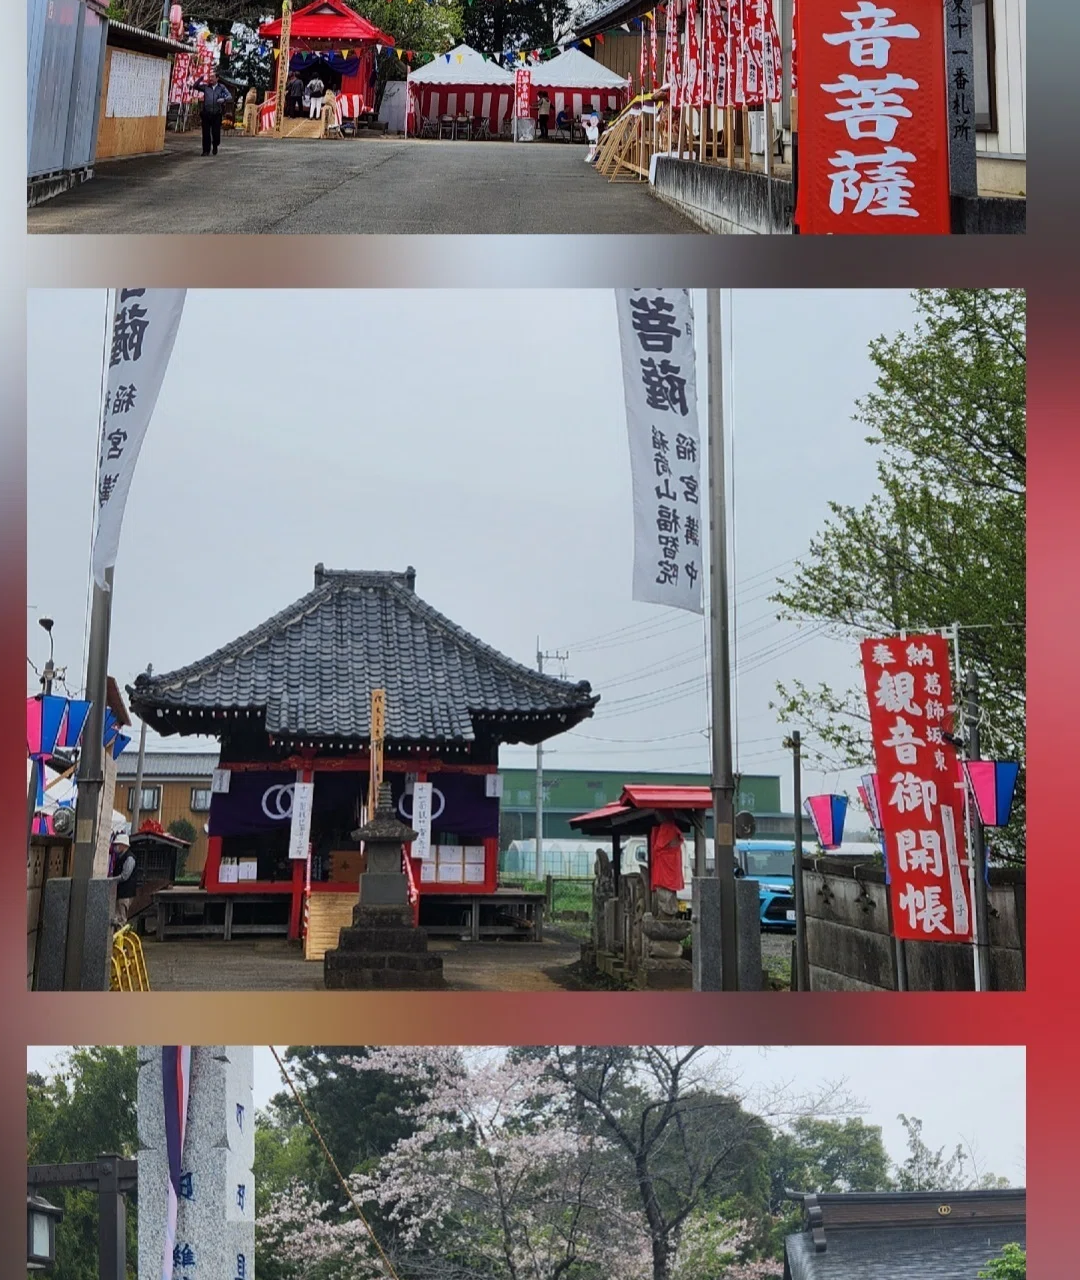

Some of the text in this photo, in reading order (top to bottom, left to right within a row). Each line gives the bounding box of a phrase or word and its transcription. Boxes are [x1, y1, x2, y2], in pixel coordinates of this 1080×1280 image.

[871, 642, 935, 669] 奉納
[923, 672, 949, 772] 葛飾坂東
[874, 671, 953, 935] 観音御開帳
